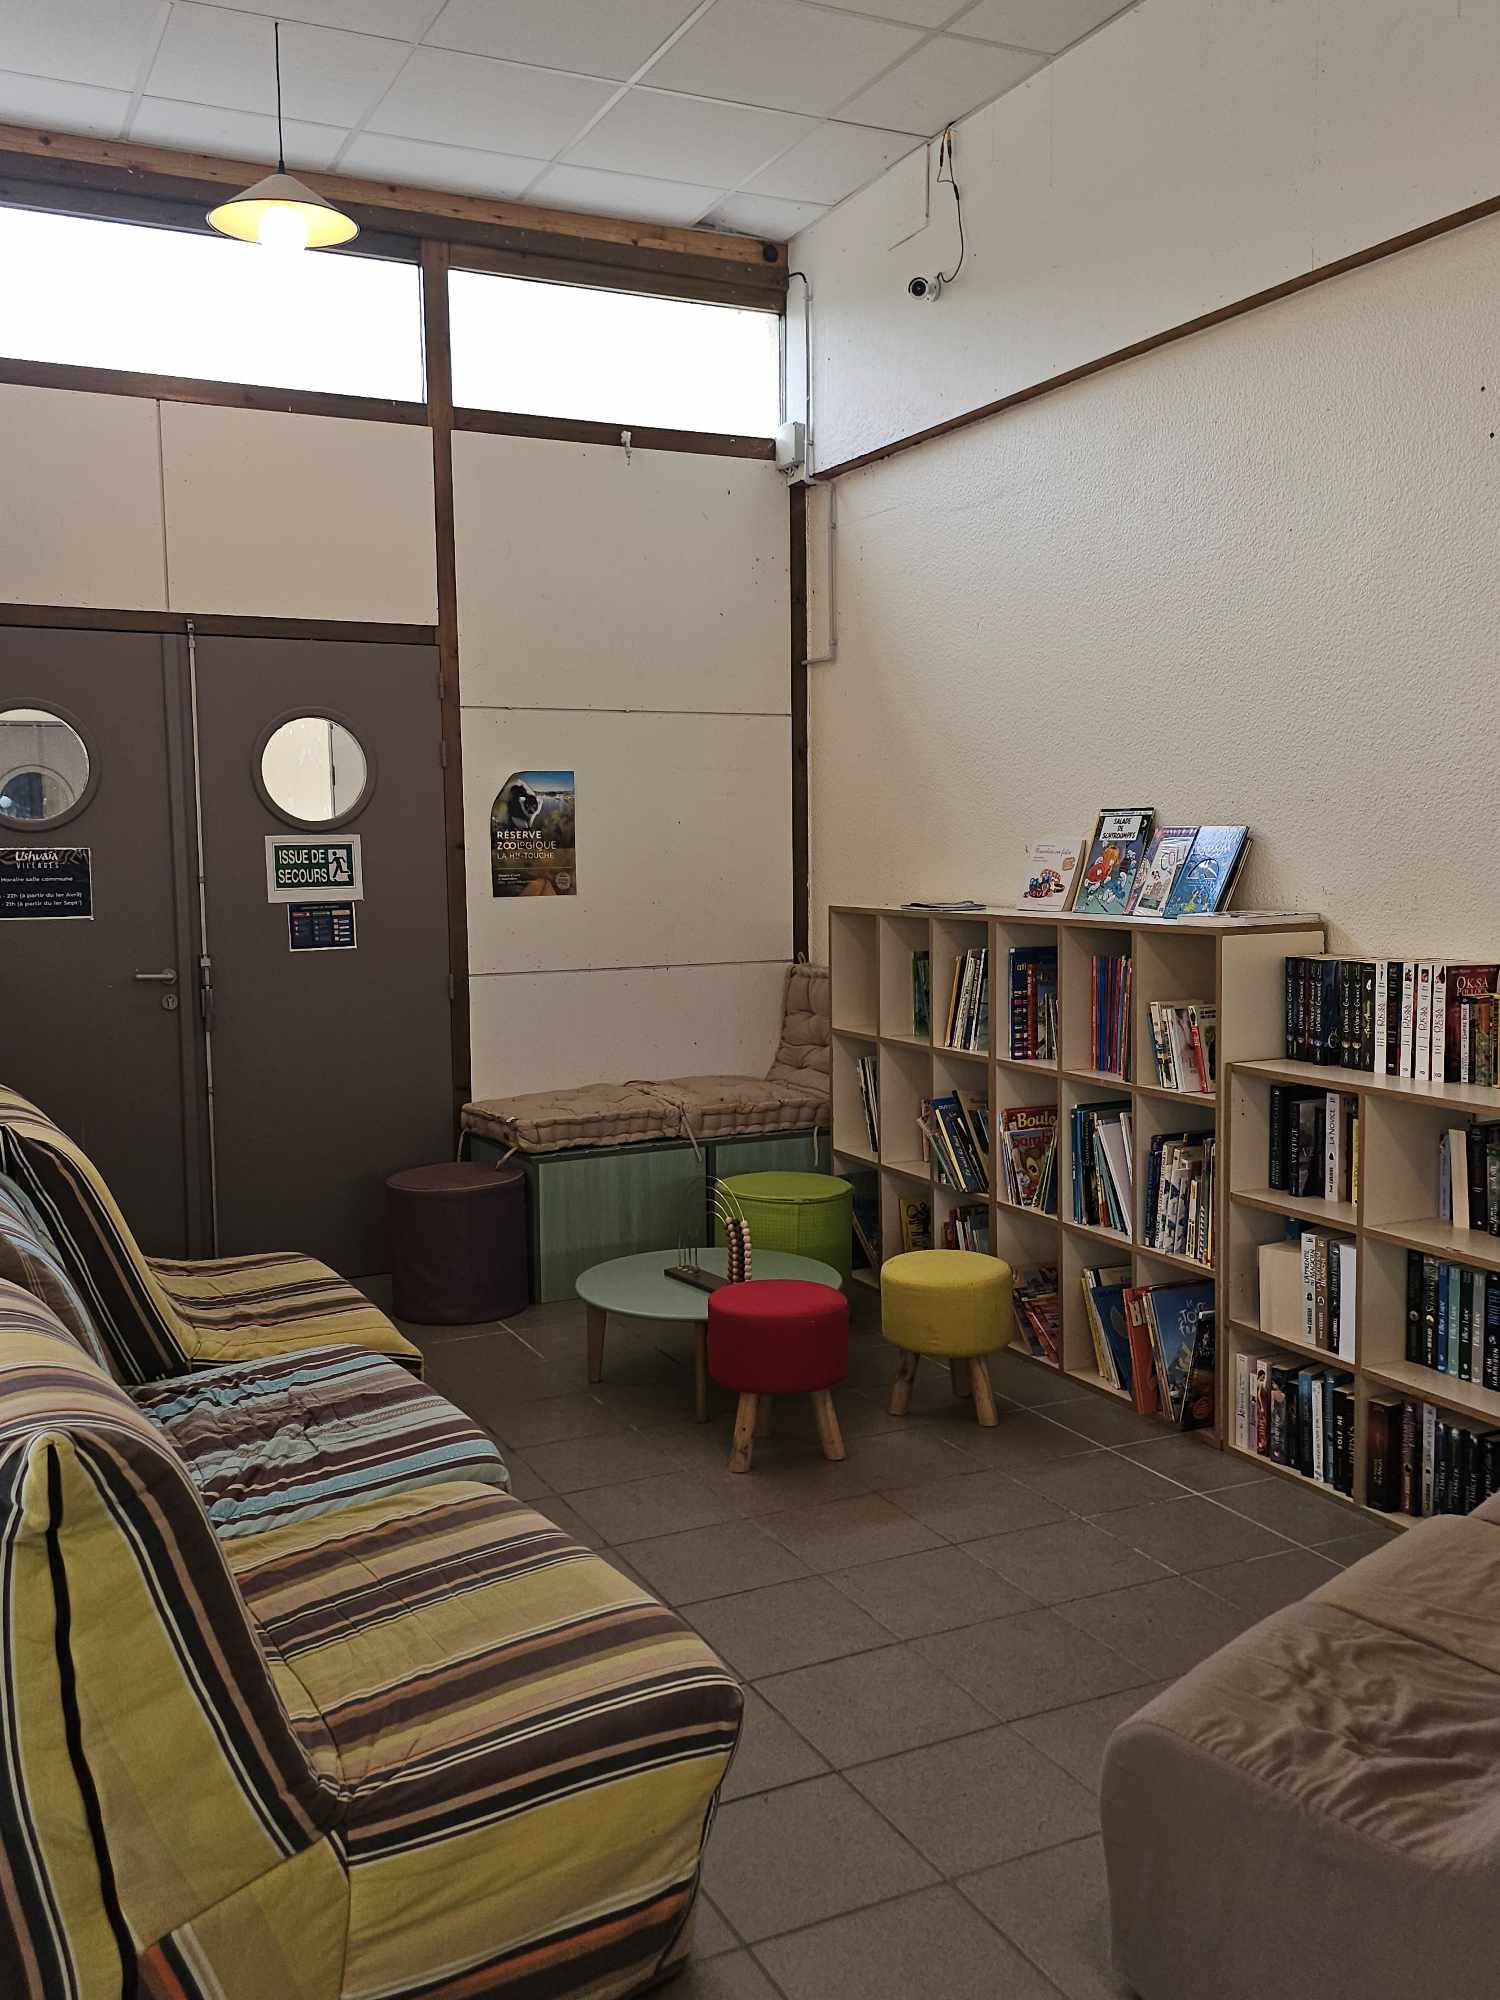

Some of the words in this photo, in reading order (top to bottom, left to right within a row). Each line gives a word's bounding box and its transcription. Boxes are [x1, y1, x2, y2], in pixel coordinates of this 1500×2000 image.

[497, 840, 557, 850] ZOOLOGIQUE
[279, 849, 309, 864] ISSUE
[311, 849, 326, 864] DE
[278, 868, 328, 883] SECOURS
[1016, 1110, 1056, 1130] Boule
